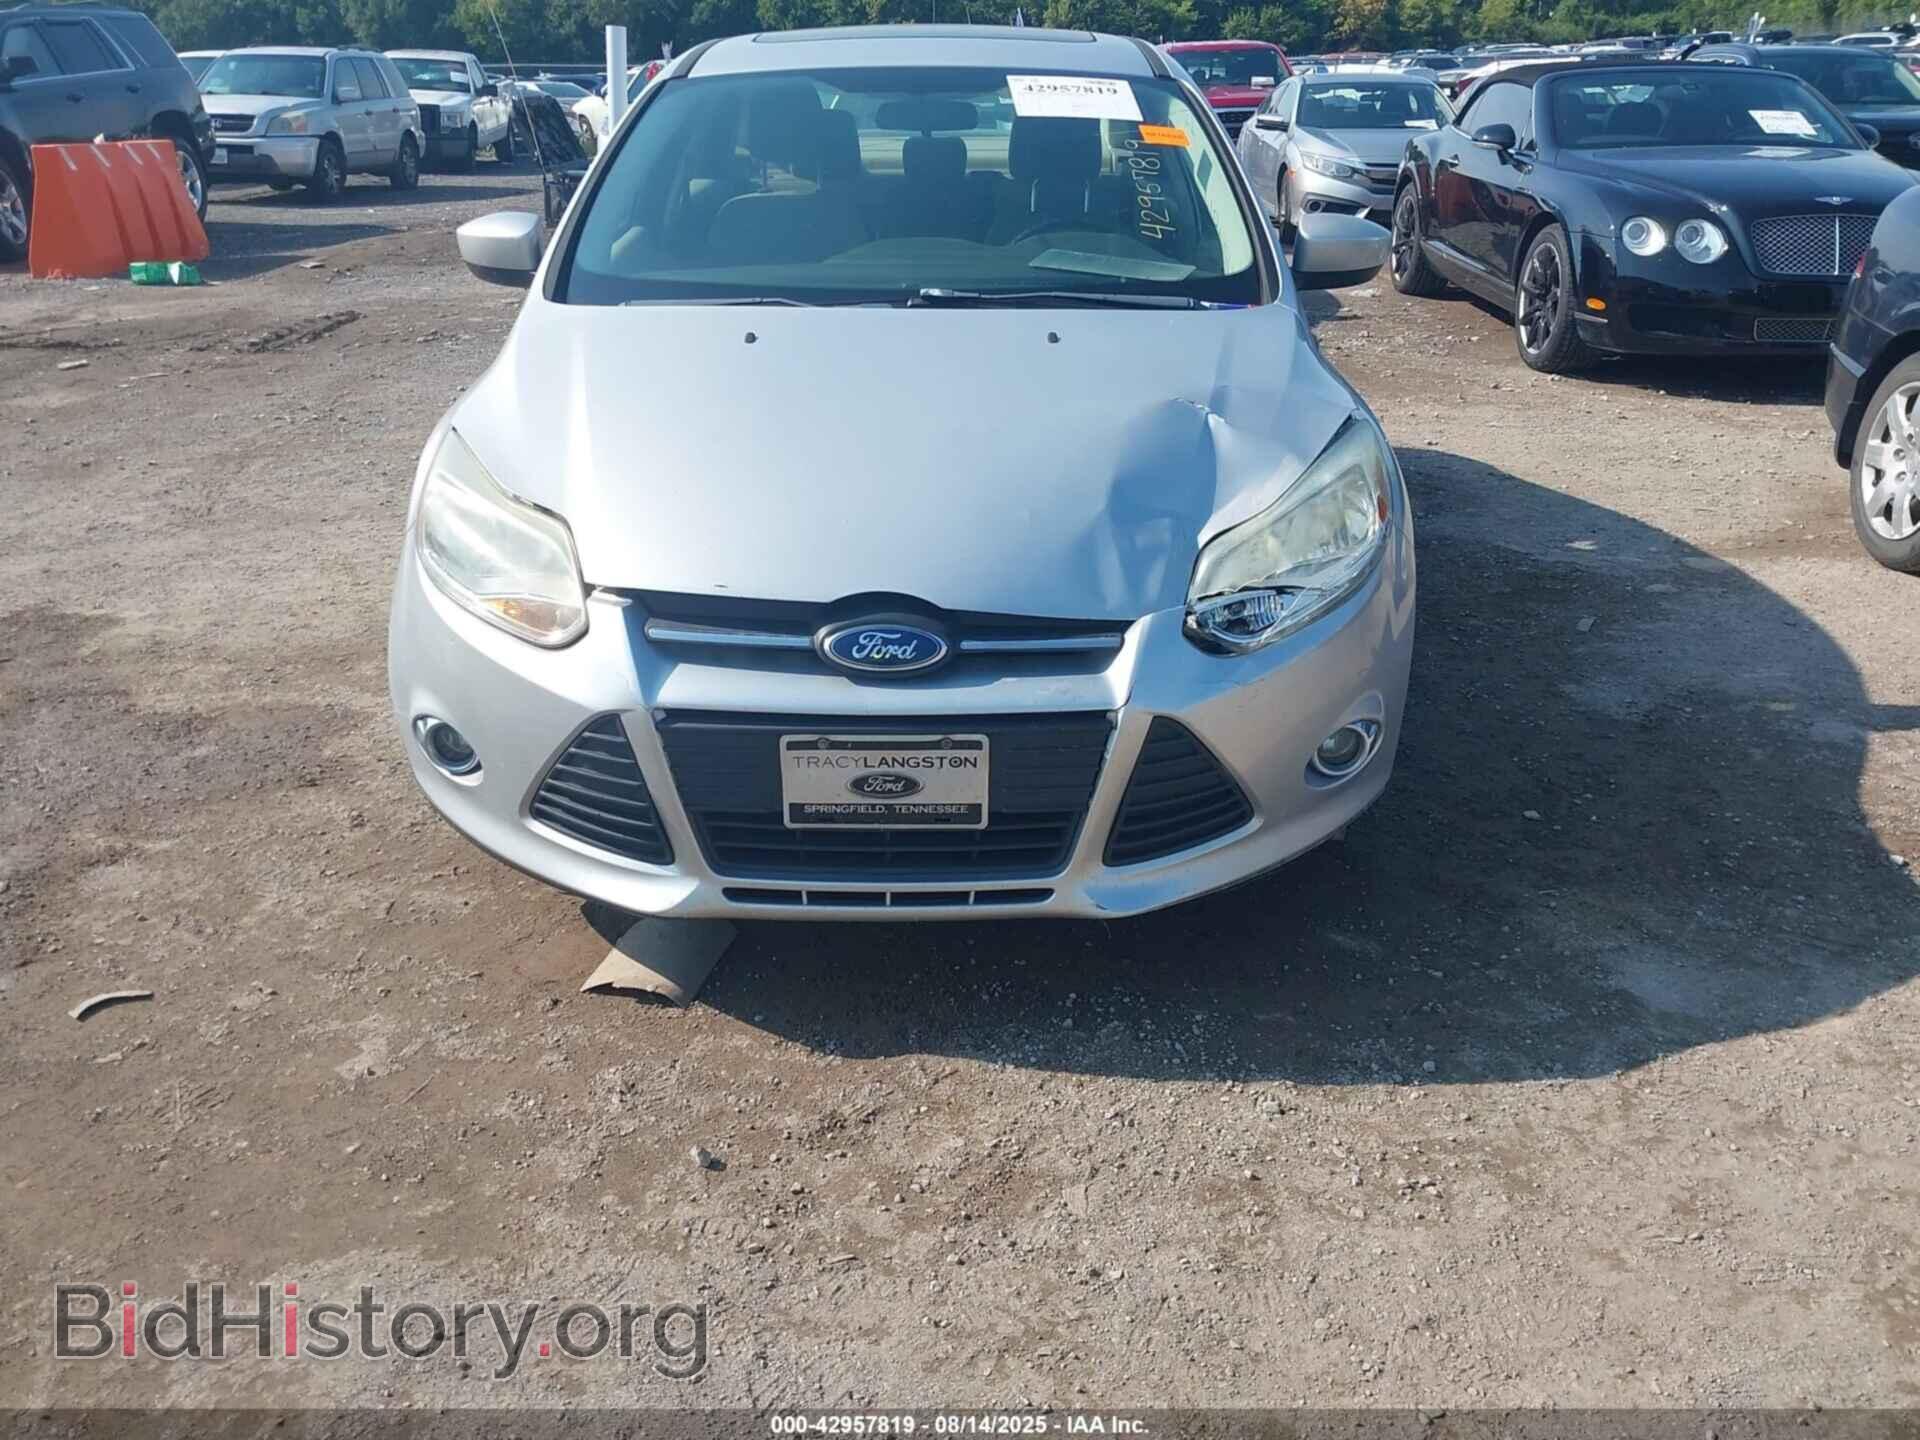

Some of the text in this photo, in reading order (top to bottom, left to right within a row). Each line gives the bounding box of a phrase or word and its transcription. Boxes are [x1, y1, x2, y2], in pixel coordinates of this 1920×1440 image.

[1124, 138, 1177, 239] 42957819
[852, 632, 917, 660] Ford
[863, 775, 905, 792] Ford
[804, 804, 968, 816] SPRINGFIELD, TENNESSEE
